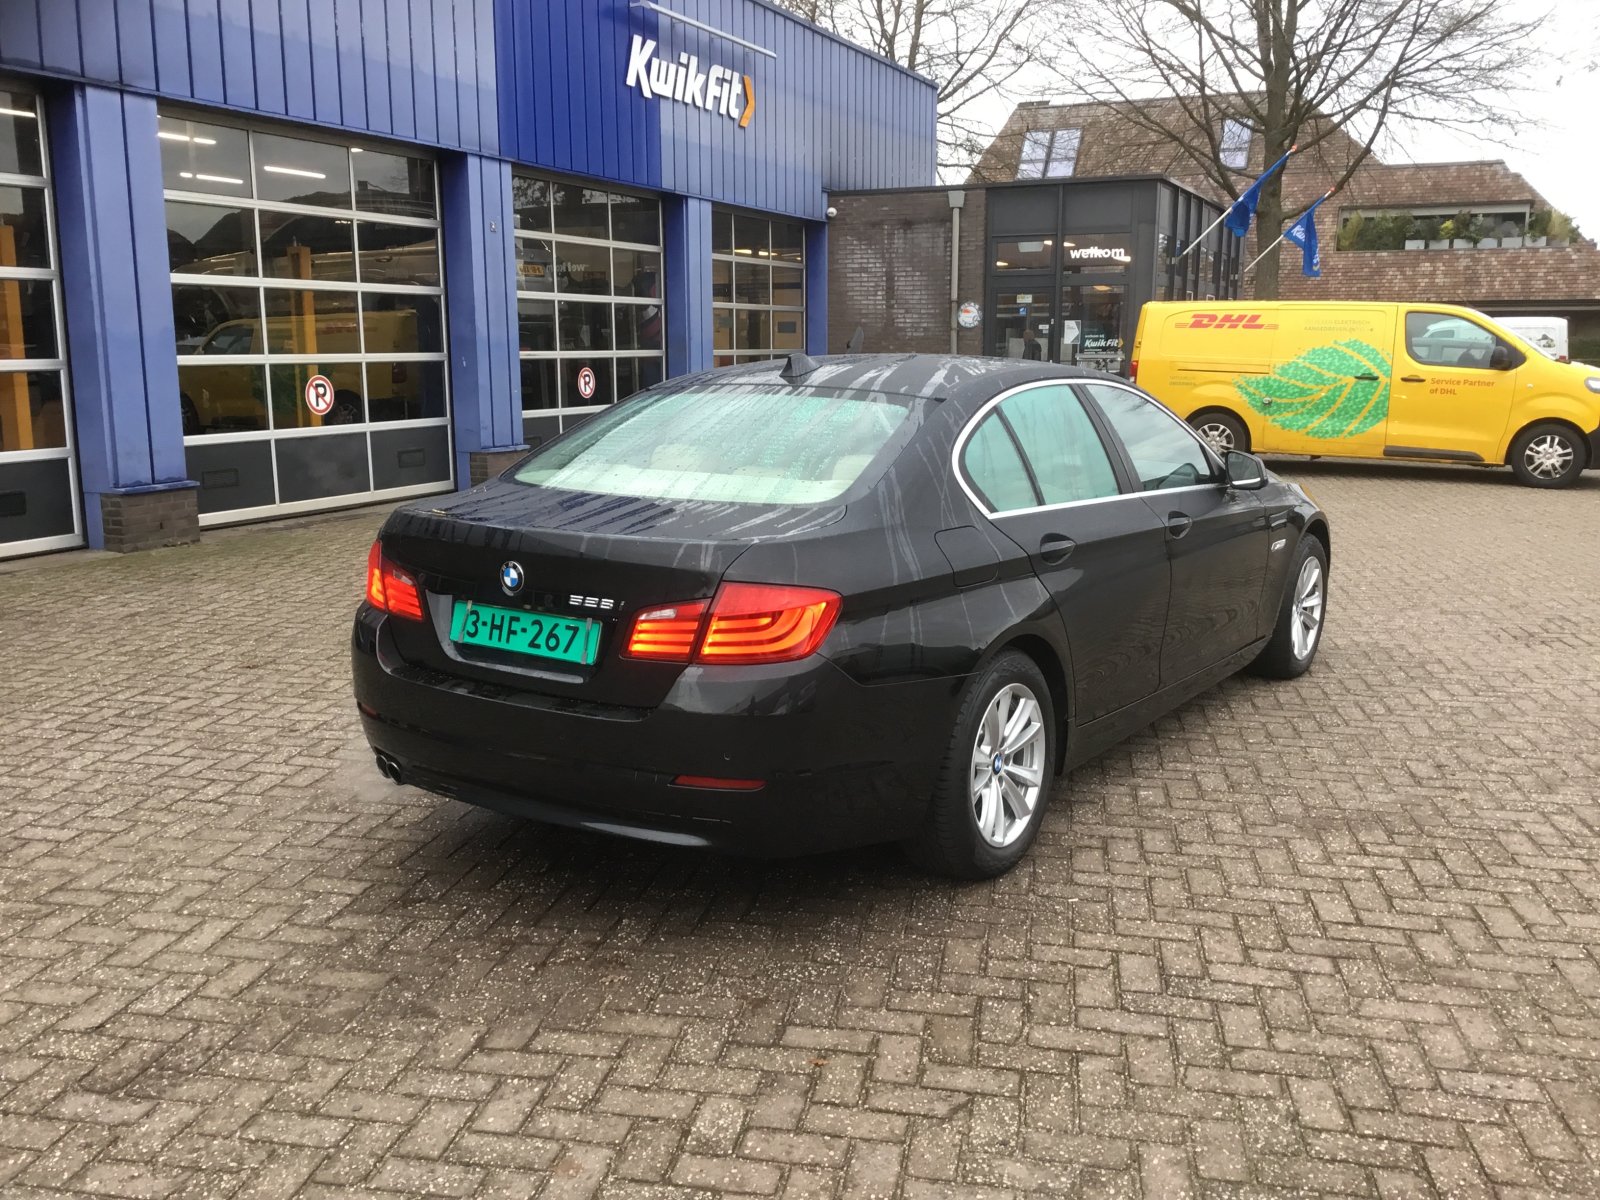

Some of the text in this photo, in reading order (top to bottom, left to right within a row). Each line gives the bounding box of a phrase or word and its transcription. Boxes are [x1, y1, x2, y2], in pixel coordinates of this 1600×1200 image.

[626, 34, 742, 119] KwikFit
[1070, 246, 1125, 259] welkom
[1189, 314, 1264, 329] DHL
[1431, 378, 1495, 387] Service Partner
[466, 610, 580, 653] 3-HF-267
